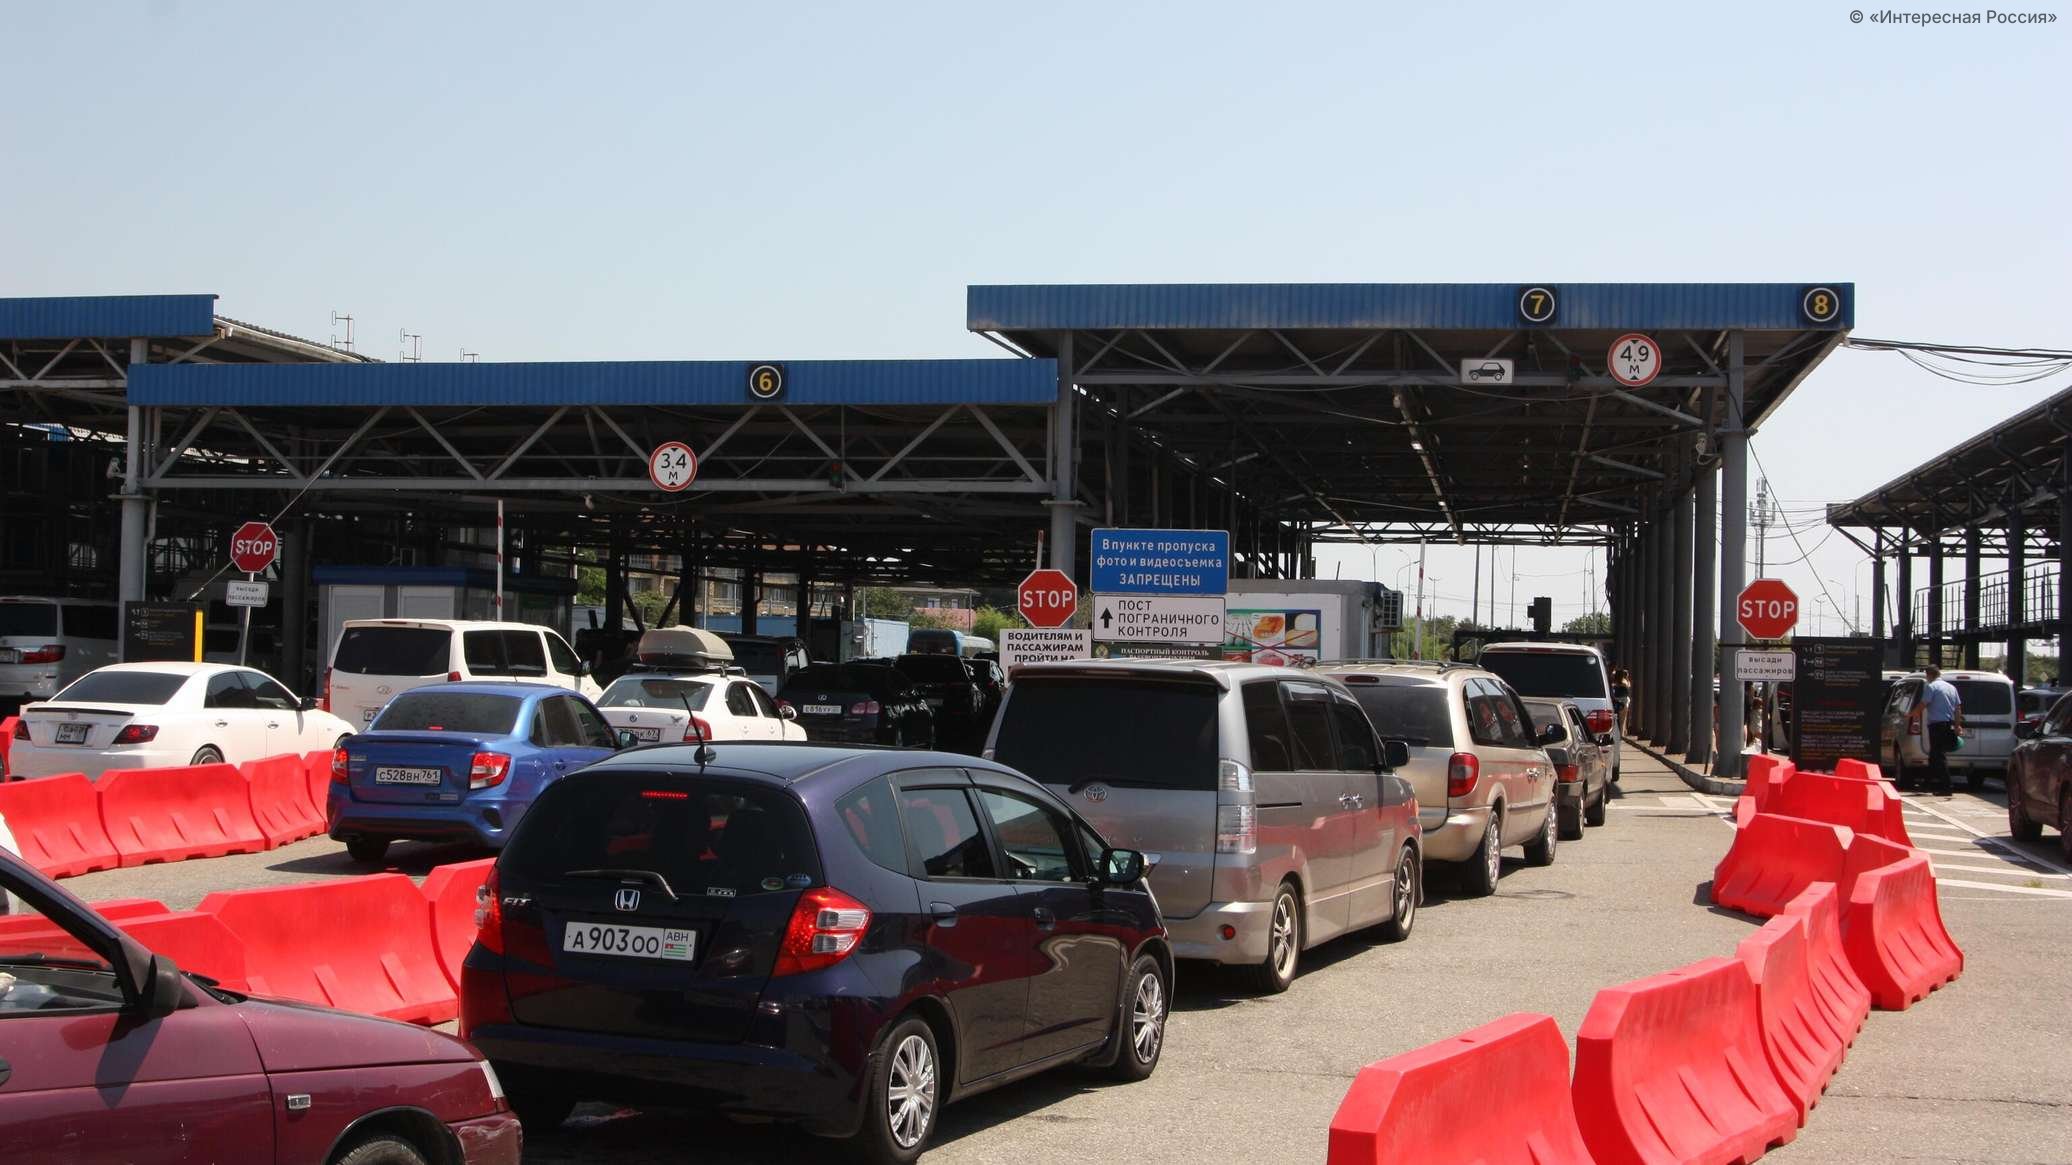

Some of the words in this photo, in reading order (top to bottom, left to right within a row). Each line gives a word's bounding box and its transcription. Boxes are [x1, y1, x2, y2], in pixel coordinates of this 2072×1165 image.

[1529, 294, 1545, 315] 7
[1813, 294, 1828, 315] 8
[759, 372, 772, 392] 6
[235, 539, 273, 556] STOP
[1102, 538, 1110, 550] В
[1112, 541, 1154, 553] пункте
[1157, 541, 1216, 554] пропуска
[1096, 555, 1127, 569] фото
[1129, 557, 1137, 567] и
[1140, 557, 1222, 569] видеосъемка
[1119, 573, 1201, 589] ЗАПРЕЩЕНЫ
[1022, 590, 1073, 608] STOP
[1118, 600, 1152, 611] ПОСТ
[1741, 600, 1795, 619] STOP
[1118, 613, 1219, 625] ПОГРАНИЧНОГО
[1008, 632, 1073, 641] ВОДИТЕЛЯМ
[1075, 632, 1083, 641] И
[1118, 626, 1188, 638] КОНТРОЛЯ
[1007, 643, 1084, 652] ПАССАЖИРАМ
[1014, 652, 1058, 662] ПРОЙТИ
[1748, 656, 1782, 664] высади
[1737, 667, 1793, 676] пассажиров
